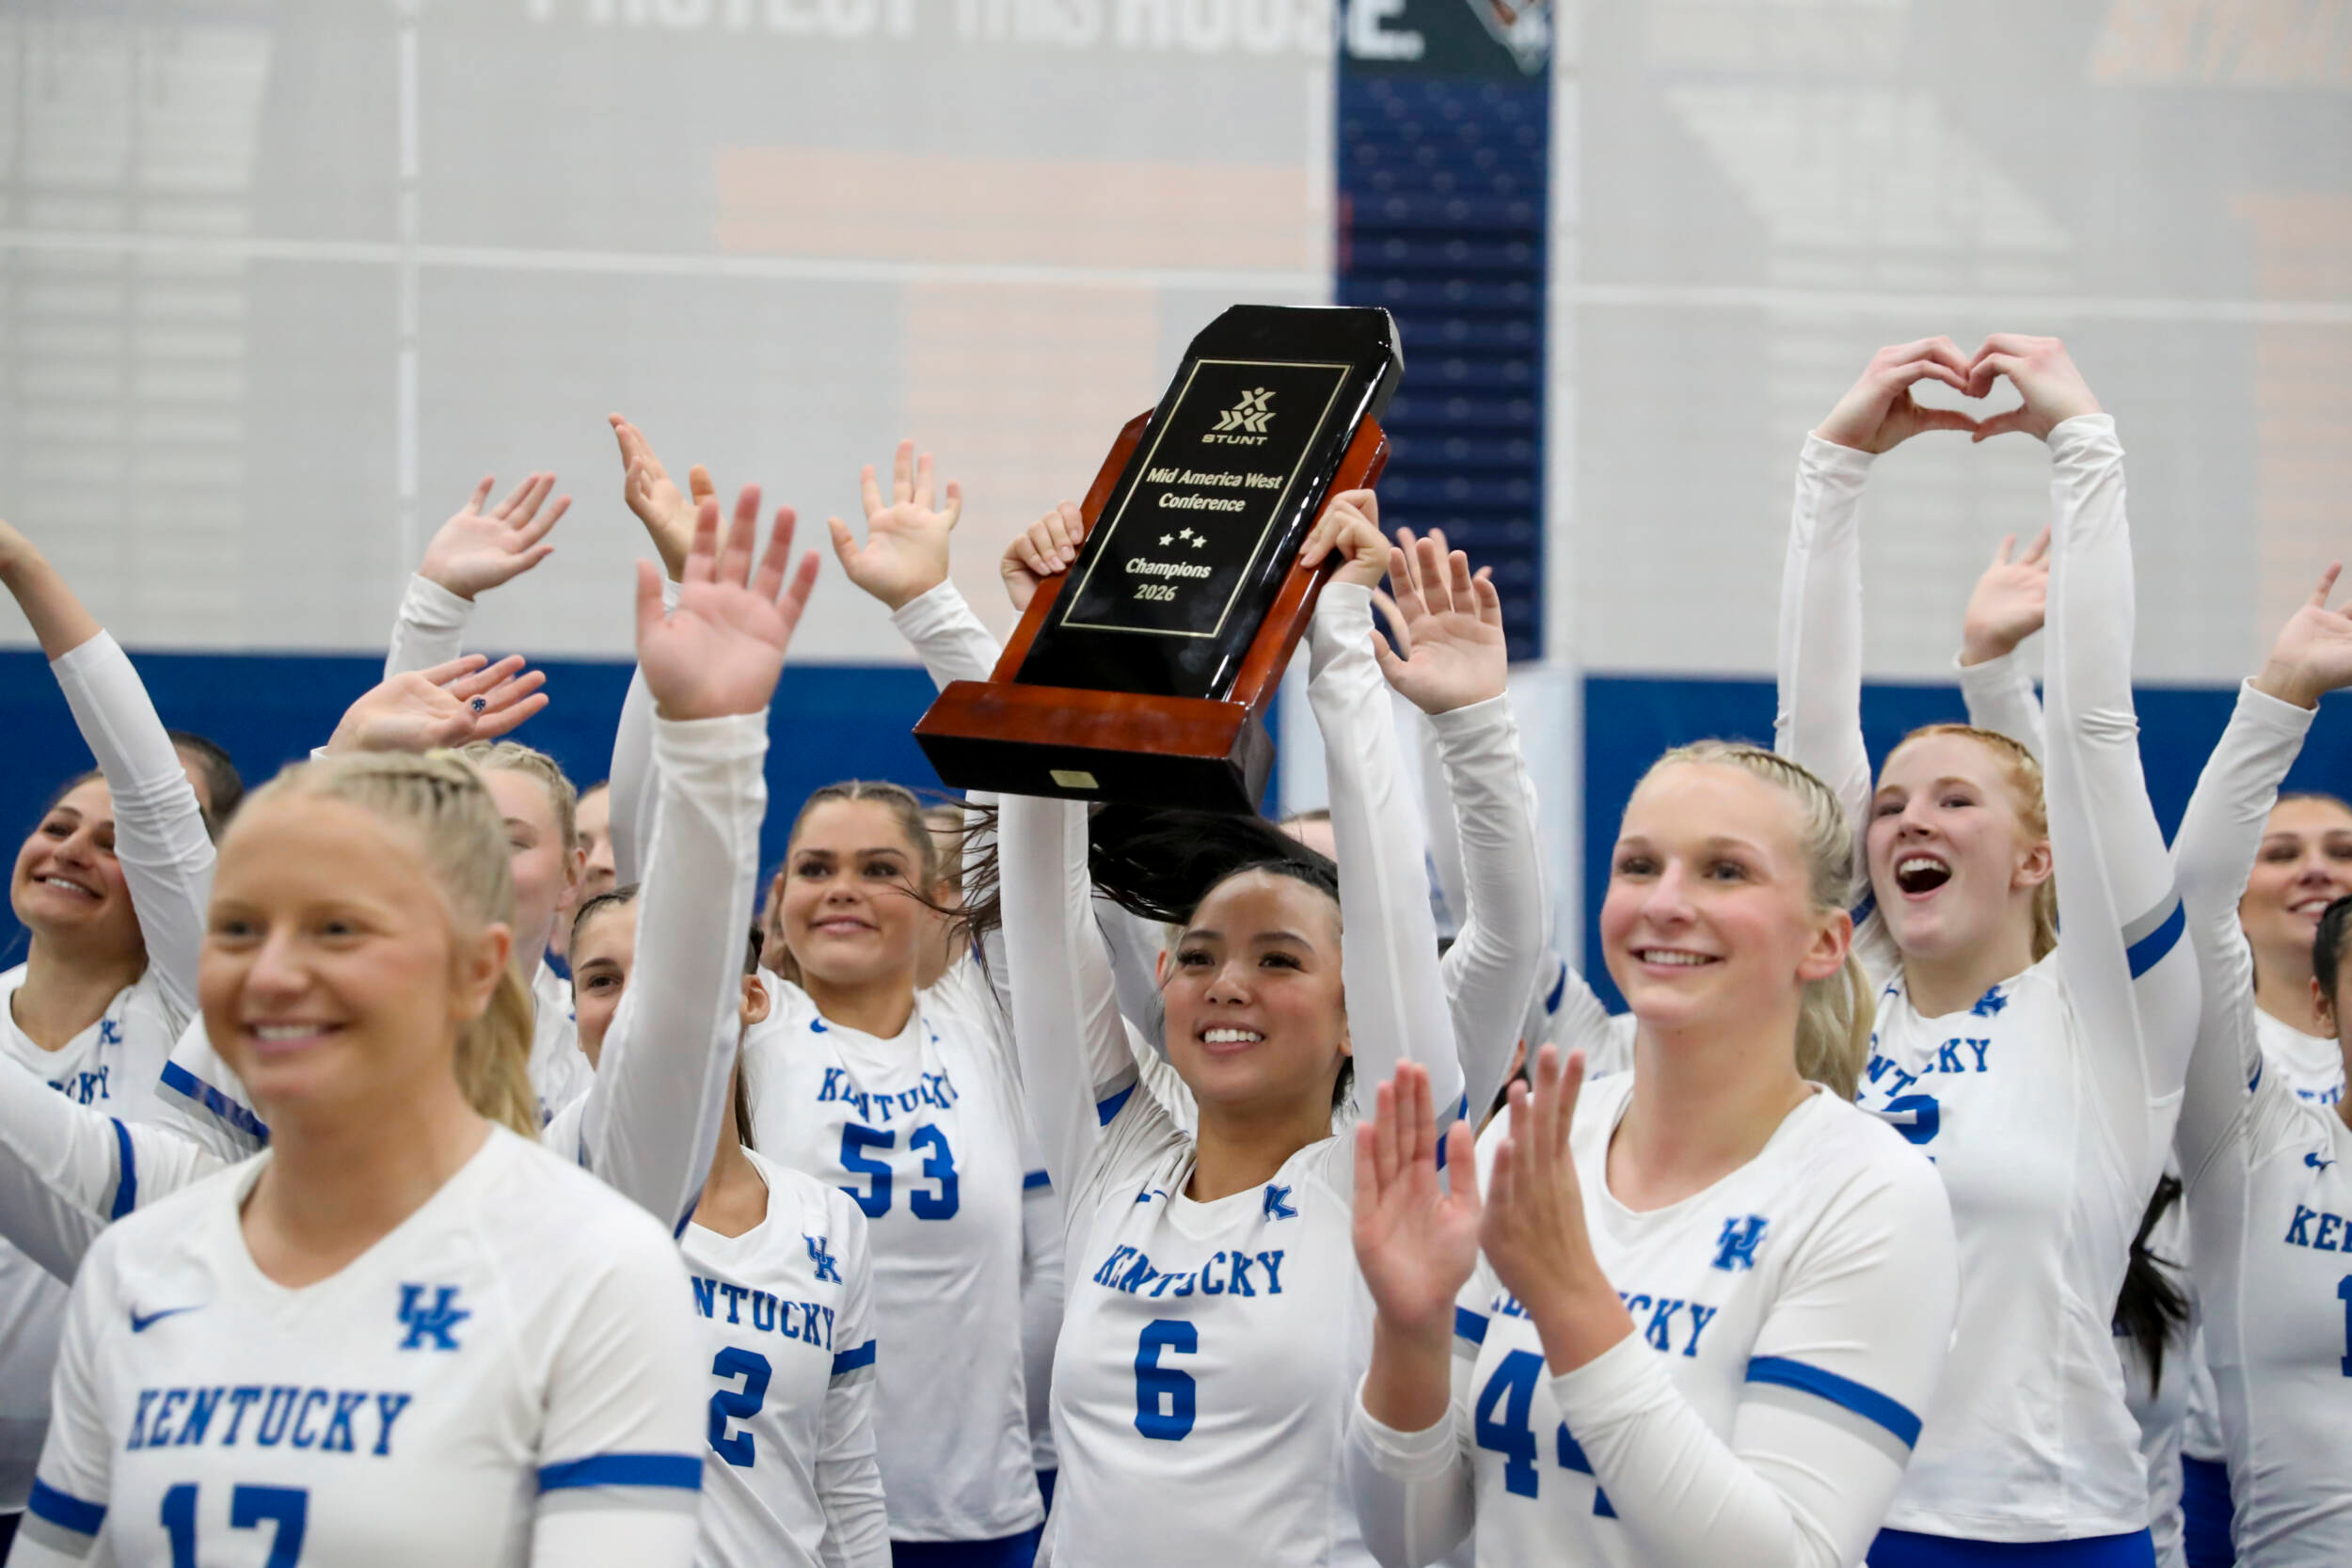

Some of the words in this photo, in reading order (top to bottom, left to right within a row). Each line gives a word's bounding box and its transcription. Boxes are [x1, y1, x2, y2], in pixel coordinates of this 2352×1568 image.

[1201, 434, 1268, 446] STUNT
[1146, 467, 1179, 483] Mid
[1177, 469, 1243, 487] America
[1245, 472, 1283, 489] West
[1158, 492, 1247, 512] Conference
[1125, 557, 1212, 580] Champions
[1133, 583, 1179, 602] 2026
[838, 1121, 960, 1220] 53
[691, 1275, 835, 1351] NTUCKY
[1134, 1319, 1198, 1442] 6
[126, 1386, 412, 1457] KENTUCKY
